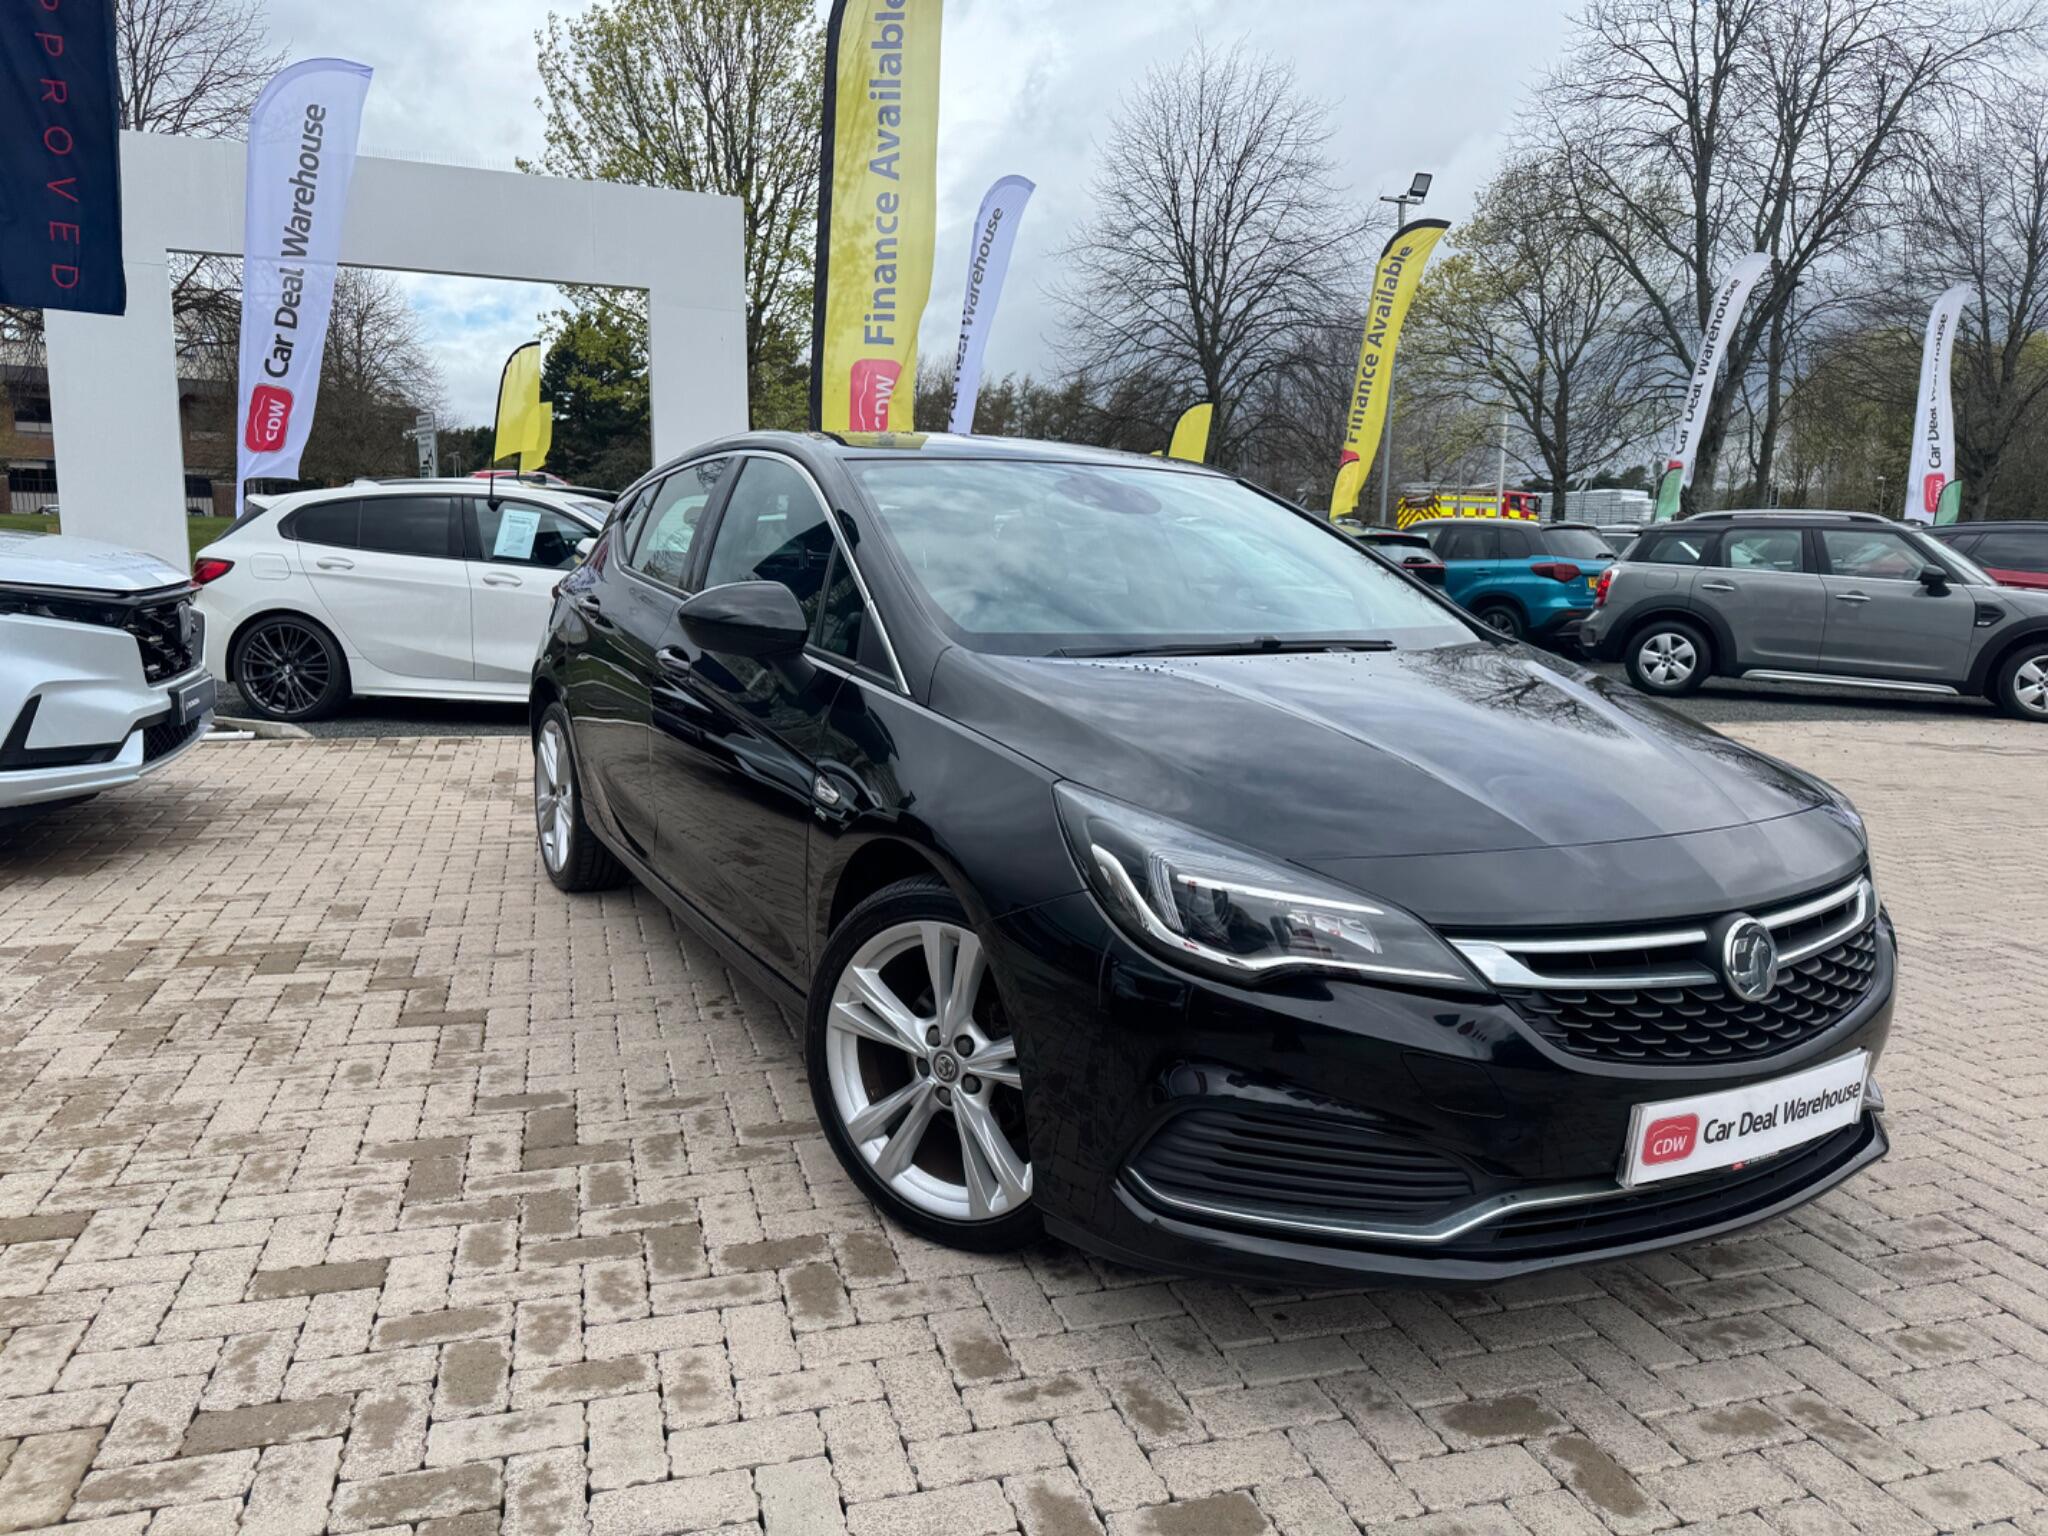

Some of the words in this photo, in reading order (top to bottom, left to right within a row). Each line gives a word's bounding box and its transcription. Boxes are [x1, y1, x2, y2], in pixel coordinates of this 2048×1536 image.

[281, 104, 327, 259] Warehouse
[275, 268, 305, 332] Deal
[865, 193, 899, 346] Finance
[1366, 246, 1413, 348] Available
[264, 334, 294, 378] Car
[265, 399, 289, 442] CDW
[1929, 444, 1942, 469] Car
[1652, 1134, 1689, 1156] CDW
[1703, 1119, 1736, 1144] Car
[1739, 1103, 1777, 1136] Deal
[1783, 1081, 1861, 1123] Warehouse
